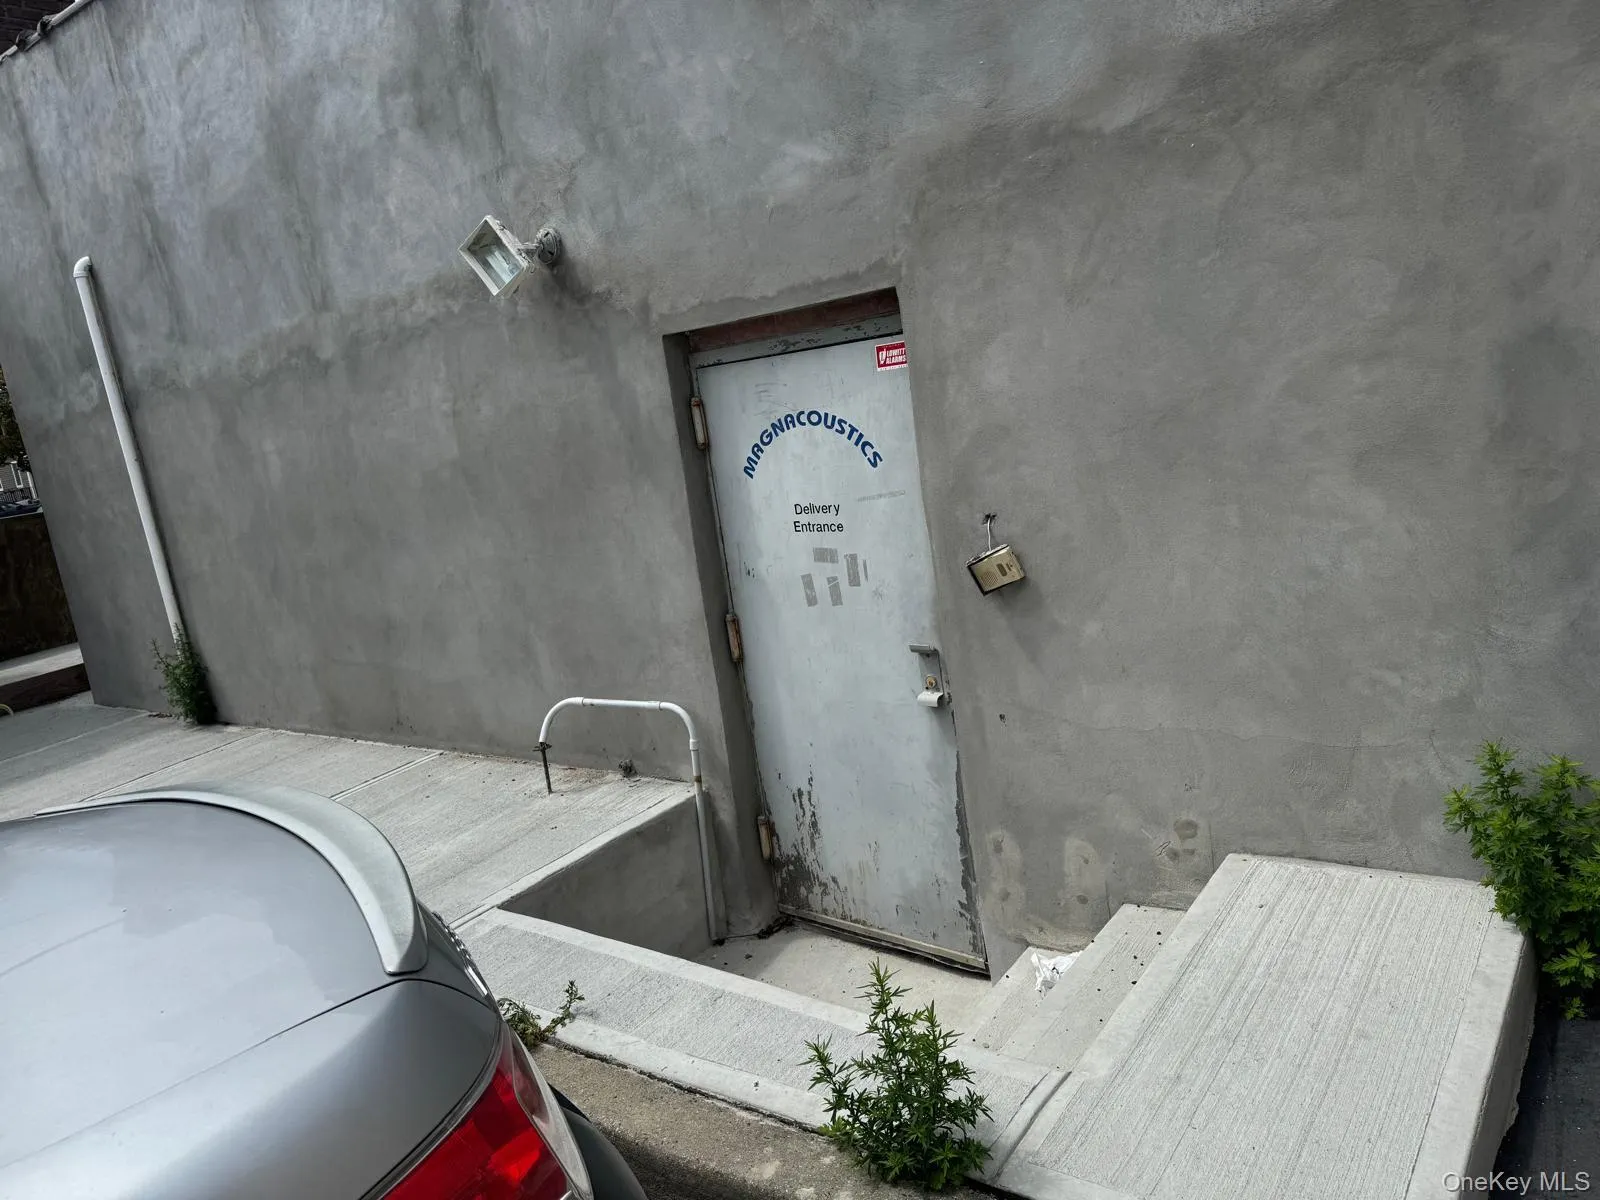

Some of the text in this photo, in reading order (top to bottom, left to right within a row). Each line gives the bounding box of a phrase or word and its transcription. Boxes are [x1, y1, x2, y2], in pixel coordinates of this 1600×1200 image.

[886, 355, 906, 365] ALARMS
[743, 410, 883, 479] MAGNACOUSTICS
[794, 503, 840, 516] Delivery
[793, 521, 844, 532] Entrance
